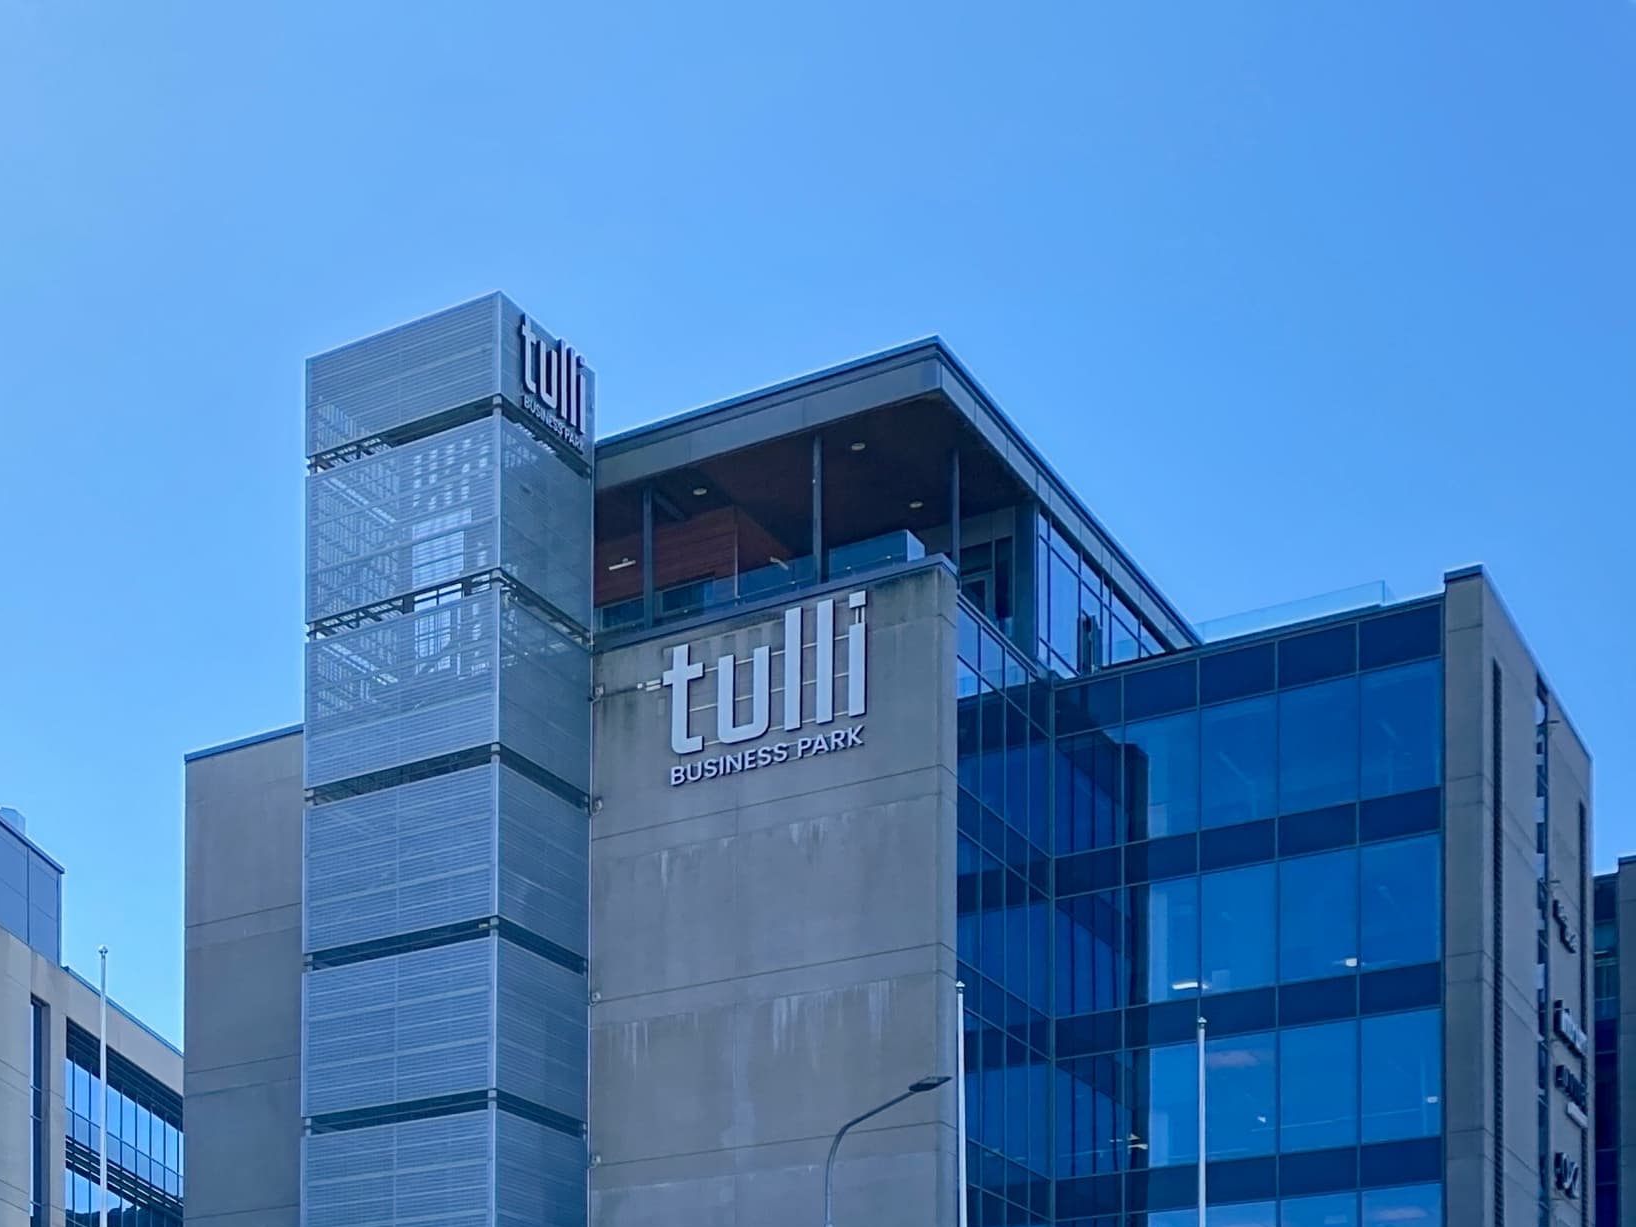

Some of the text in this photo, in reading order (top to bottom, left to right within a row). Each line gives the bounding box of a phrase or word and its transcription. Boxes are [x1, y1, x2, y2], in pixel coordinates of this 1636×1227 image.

[522, 313, 586, 434] tulli
[524, 395, 585, 449] BUSINESS PARK
[663, 590, 867, 754] tulli
[671, 725, 865, 786] BUSINESS PARK
